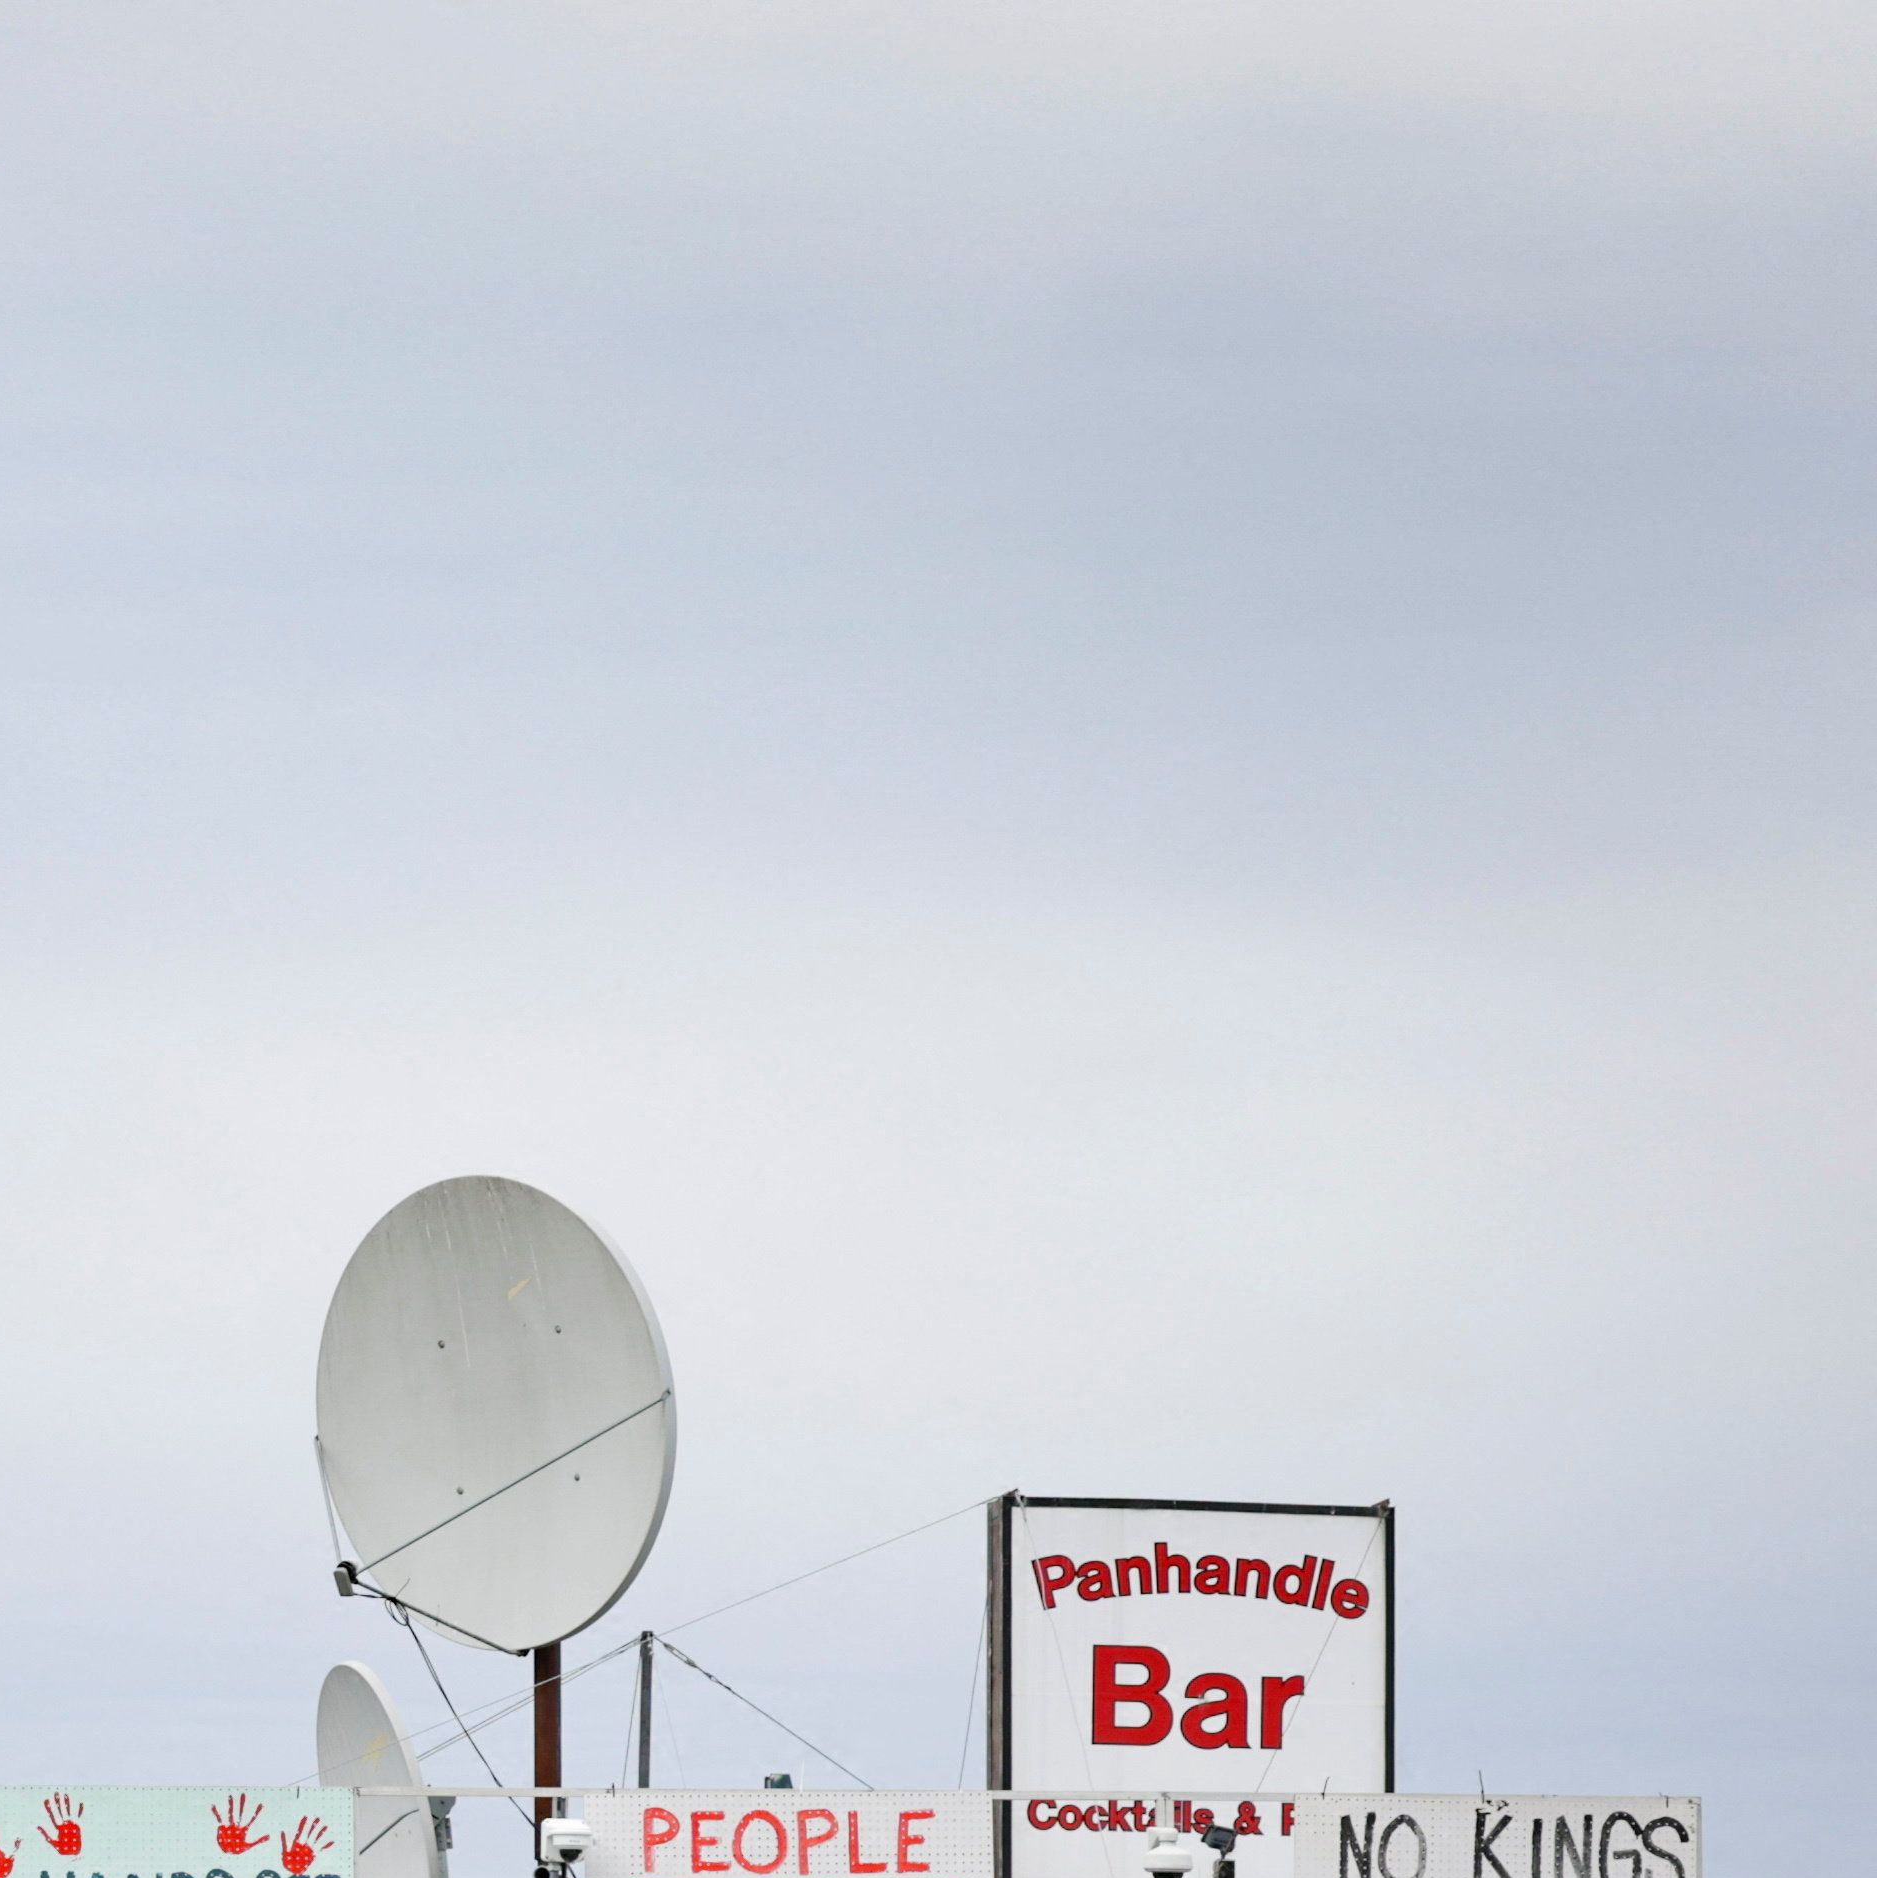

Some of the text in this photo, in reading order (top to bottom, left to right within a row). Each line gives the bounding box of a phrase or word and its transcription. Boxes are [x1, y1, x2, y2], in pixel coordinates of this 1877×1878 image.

[1032, 1542, 1370, 1619] Panhandle
[1092, 1645, 1305, 1749] Bar
[643, 1806, 936, 1876] PEOPLE
[1027, 1800, 1214, 1834] Cocktils
[1234, 1801, 1263, 1835] &
